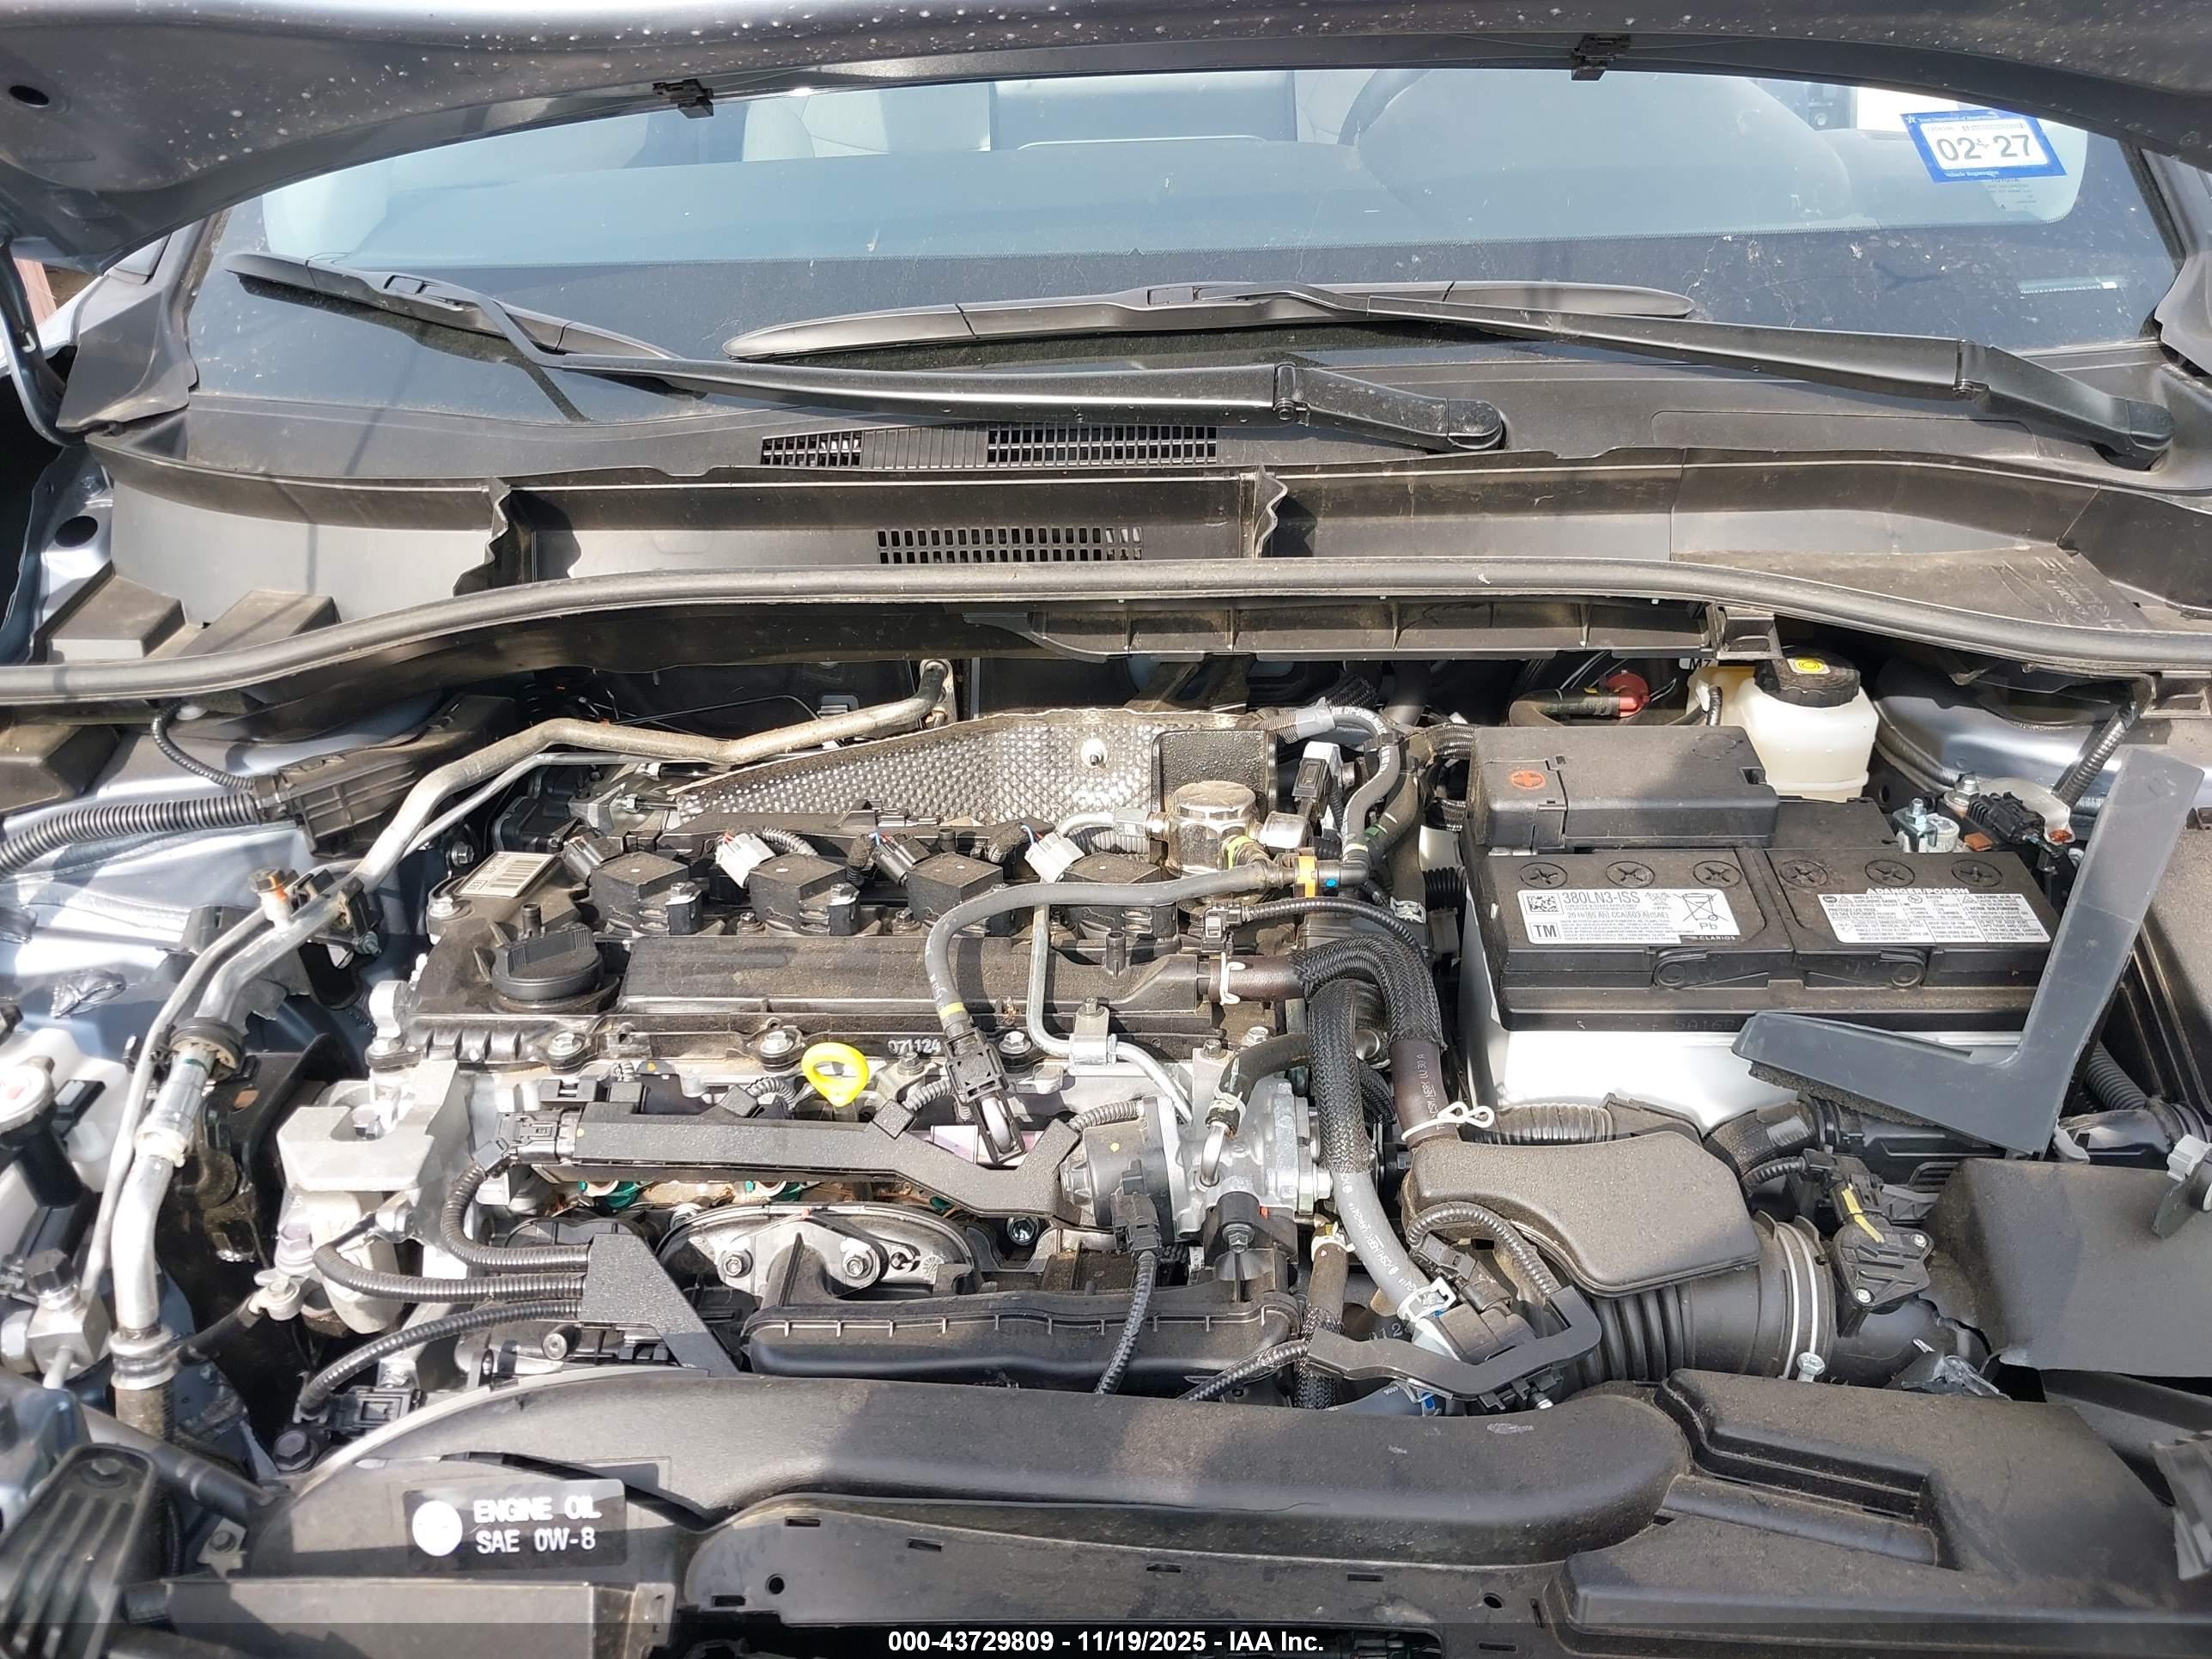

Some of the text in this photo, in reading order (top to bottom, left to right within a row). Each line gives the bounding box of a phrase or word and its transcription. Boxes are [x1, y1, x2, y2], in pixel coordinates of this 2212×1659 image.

[1936, 135, 2029, 161] 02 27
[1562, 891, 1640, 903] 380LN3-ISS
[1534, 925, 1557, 939] TM
[473, 1495, 602, 1522] ENGINE OIL
[476, 1527, 596, 1553] SAE 0W-8
